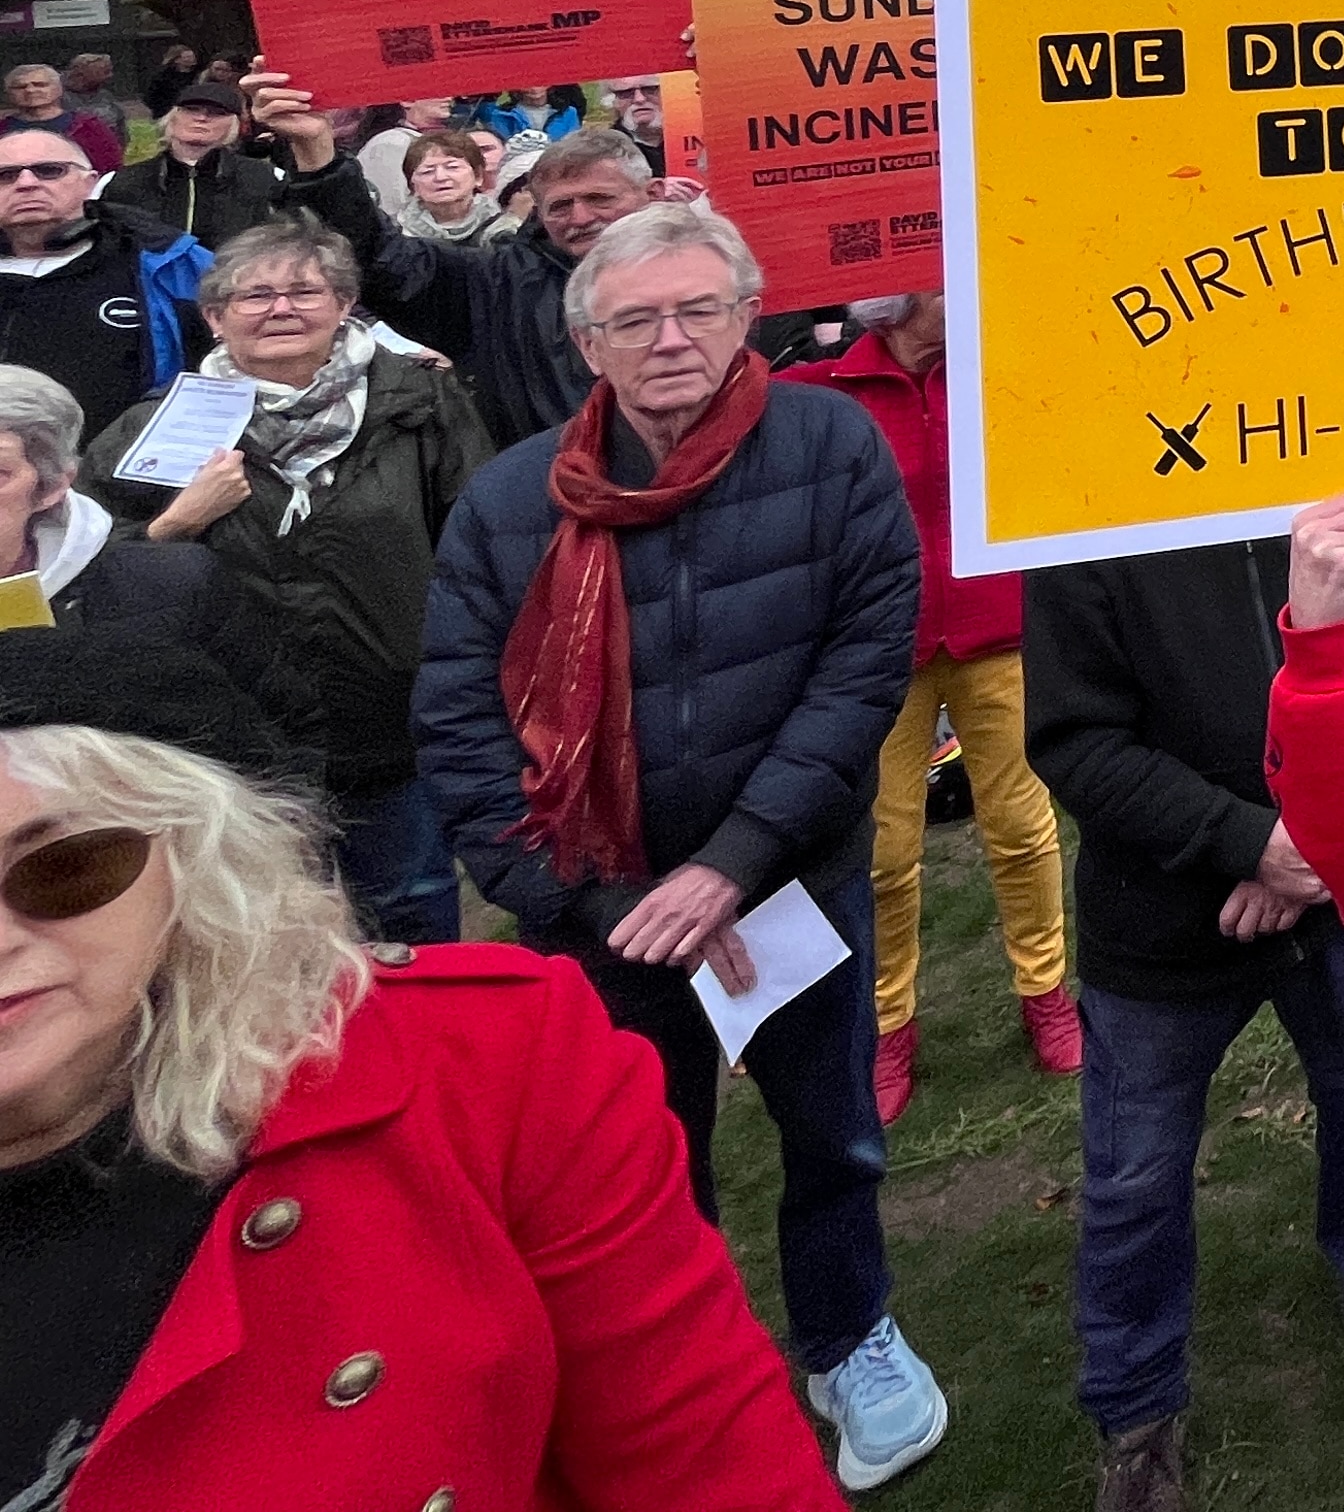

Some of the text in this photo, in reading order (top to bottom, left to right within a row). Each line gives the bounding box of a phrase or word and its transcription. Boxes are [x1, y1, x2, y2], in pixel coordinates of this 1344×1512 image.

[551, 10, 601, 29] MP
[797, 38, 936, 88] WAS
[1046, 36, 1166, 88] WE
[747, 100, 937, 152] INCINE
[755, 153, 931, 185] WE ARE NOT YOUR
[890, 212, 938, 227] DAVID
